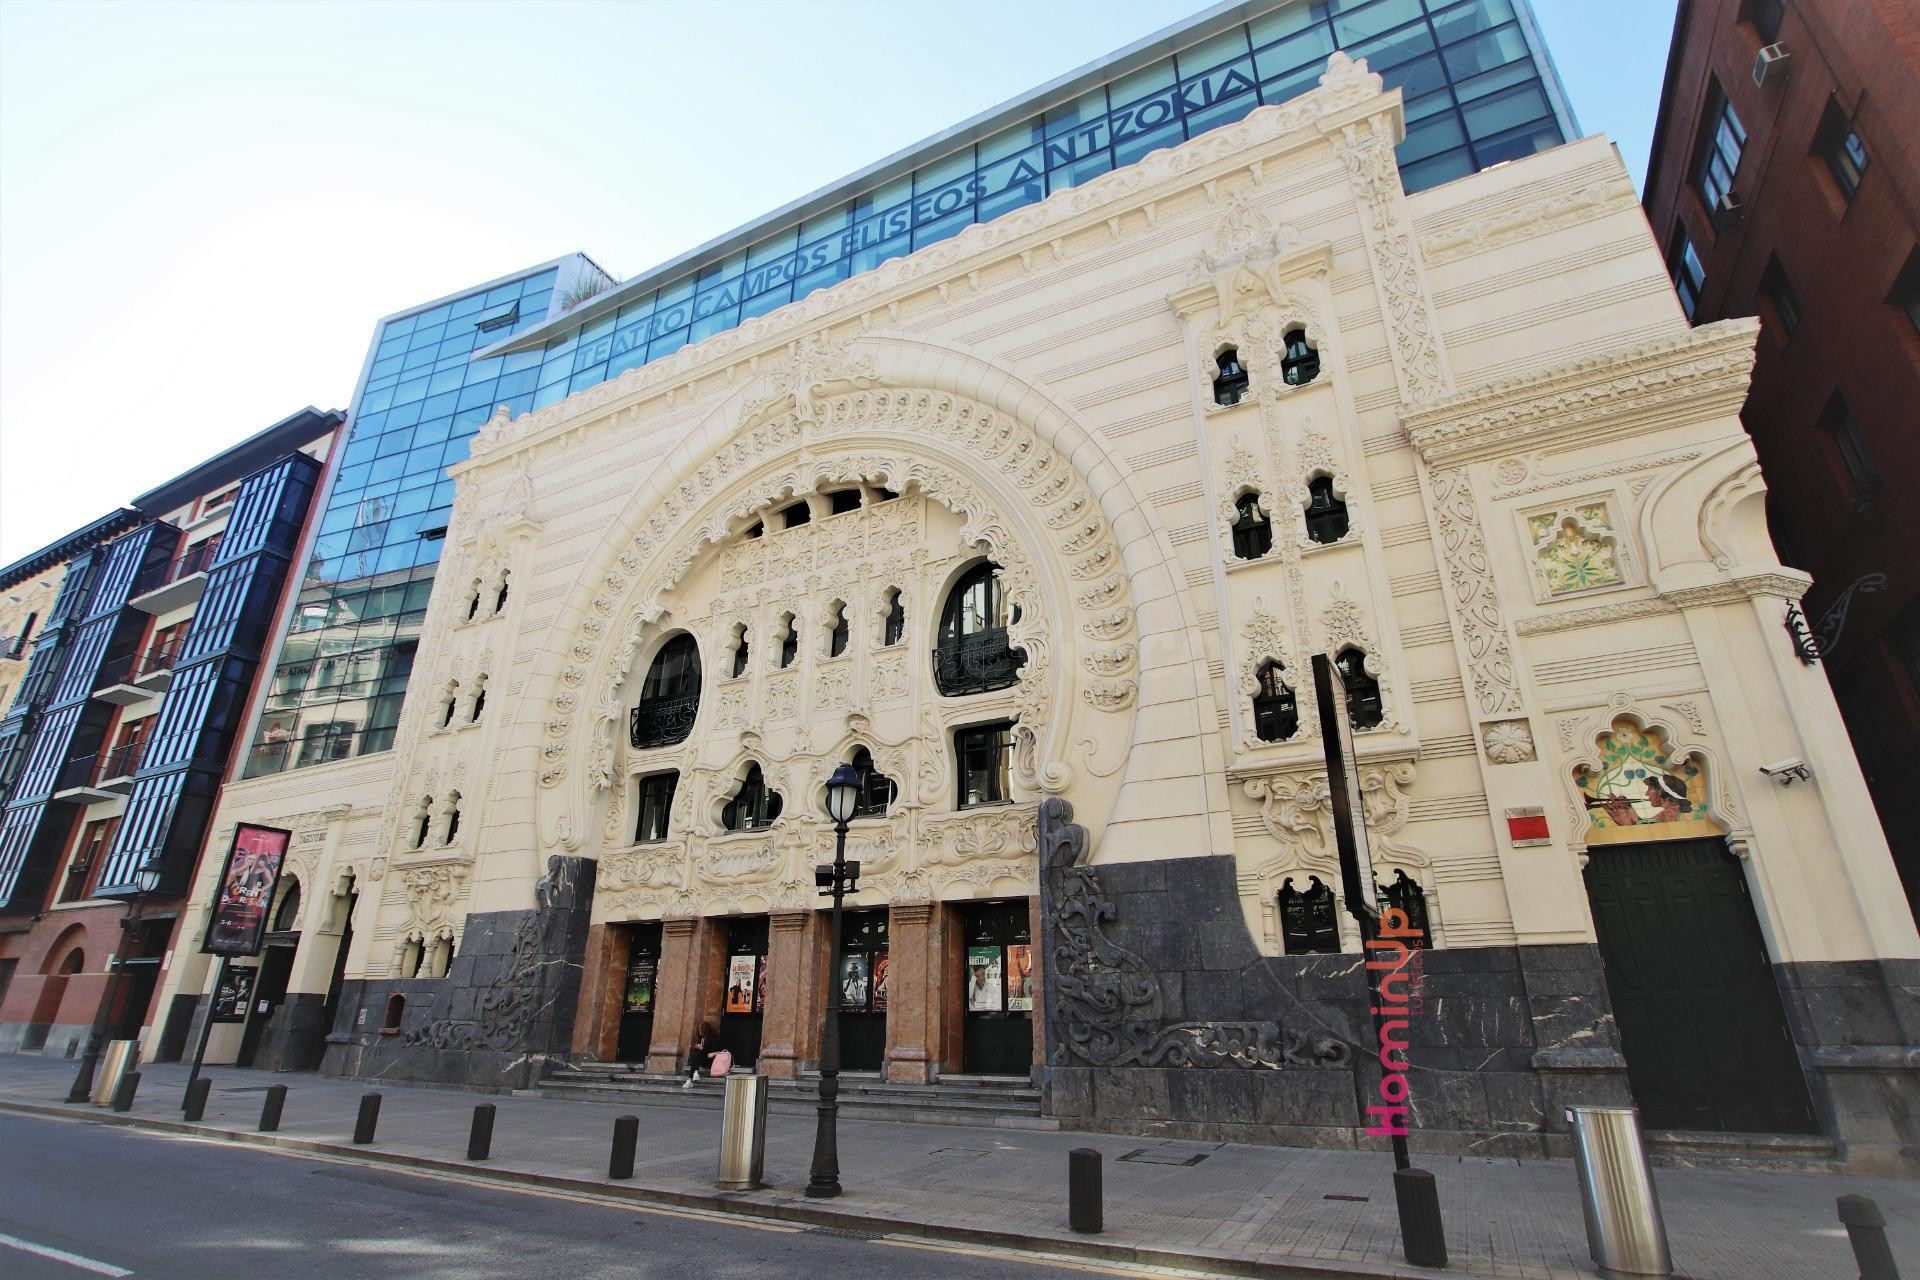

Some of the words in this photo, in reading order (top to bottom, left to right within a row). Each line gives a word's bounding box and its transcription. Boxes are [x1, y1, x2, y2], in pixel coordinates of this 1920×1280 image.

[579, 308, 686, 368] TEATRO
[696, 244, 830, 317] CAMPOS
[840, 175, 988, 256] ELISEOS
[1004, 68, 1258, 189] ANTZOKIA
